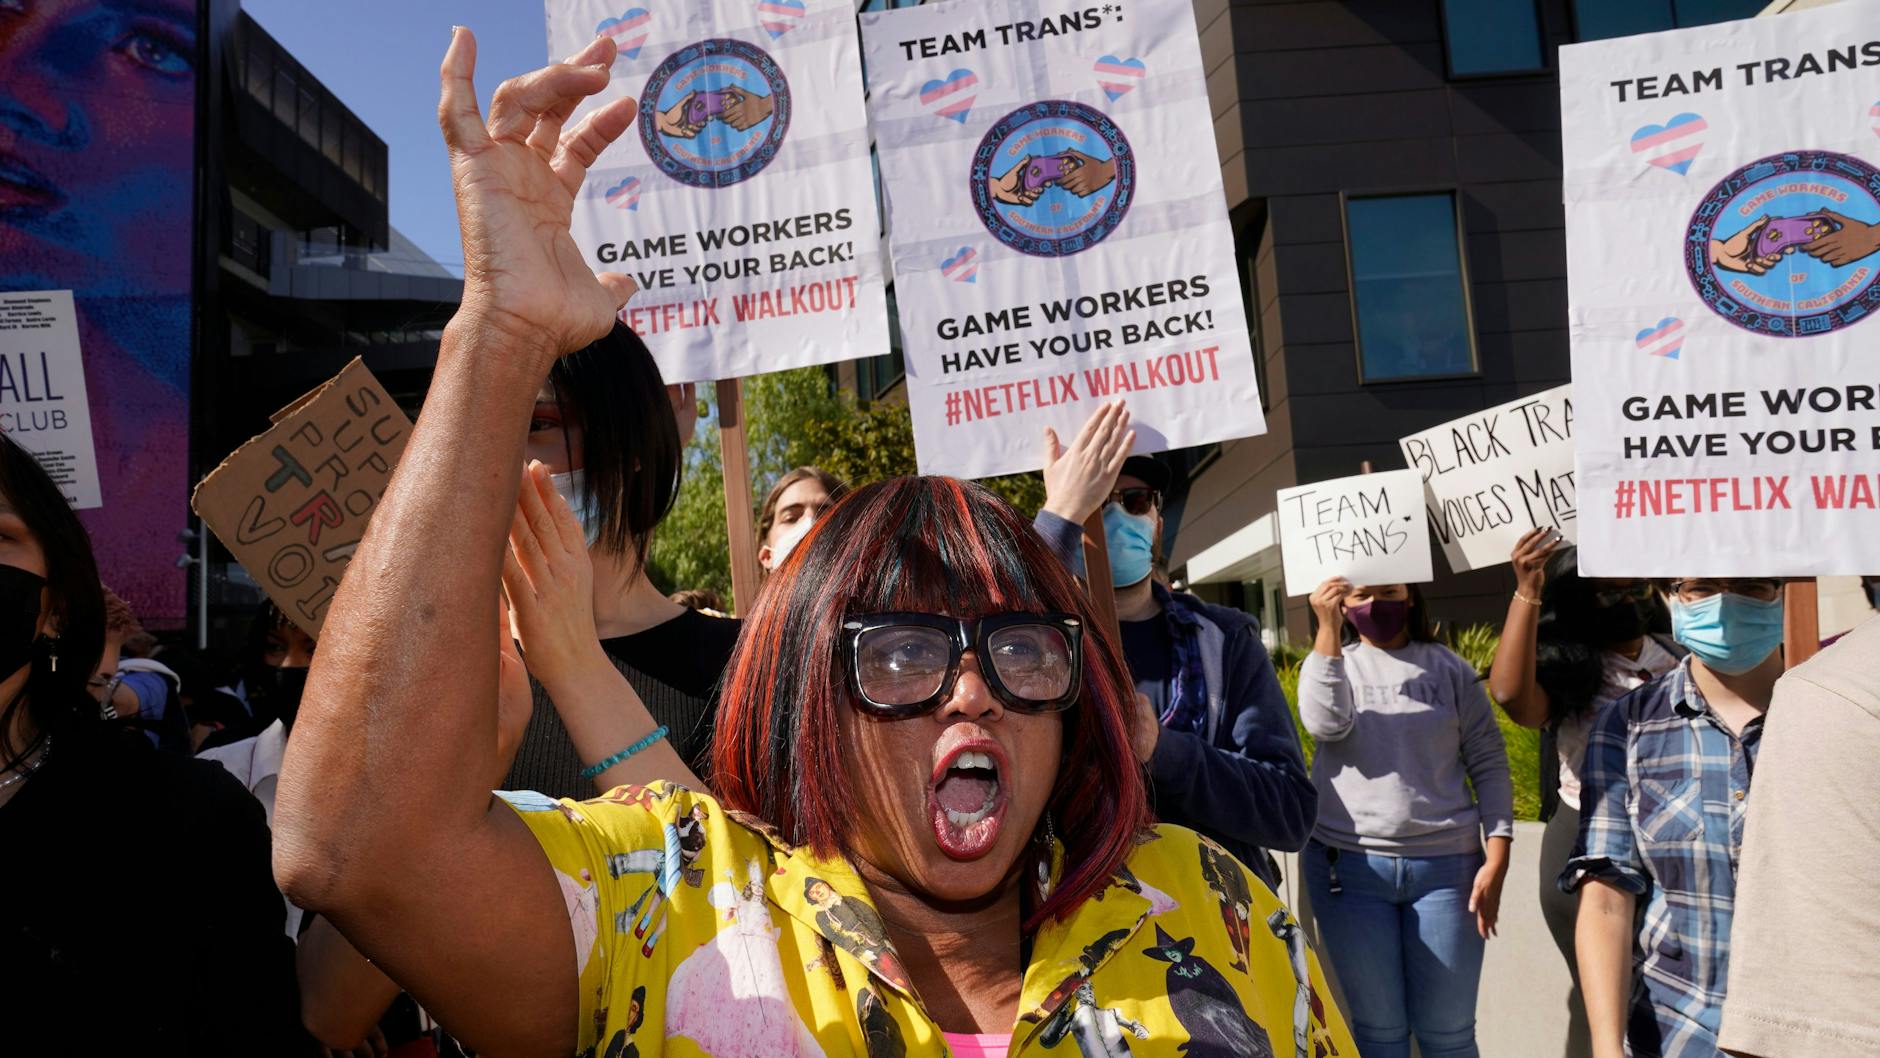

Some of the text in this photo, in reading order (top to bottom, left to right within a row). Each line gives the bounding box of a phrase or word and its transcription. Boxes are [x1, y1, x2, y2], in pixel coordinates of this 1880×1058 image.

[899, 29, 987, 60] TEAM
[1611, 41, 1880, 102] TEAM TRANS
[1738, 182, 1848, 217] GAME WORKERS
[597, 208, 852, 264] GAME WORKERS
[627, 241, 855, 290] VE YOUR BACK!
[1731, 267, 1870, 310] SOUTHERN CALIFORNIA
[1789, 272, 1808, 284] OF
[733, 276, 858, 323] WALKOUT
[937, 275, 1210, 340] GAME WORKERS
[942, 310, 1215, 374] HAVE YOUR BACK!
[945, 346, 1220, 426] #NETFLIX WALKOUT
[1622, 385, 1880, 421] GAME WOR
[1406, 413, 1511, 484] BLACK
[1624, 433, 1727, 459] HAVE
[1740, 427, 1857, 455] YOUR
[1284, 487, 1392, 528] TEAM
[1426, 484, 1513, 544] VOICES
[1614, 474, 1880, 519] #NETFLIX WA
